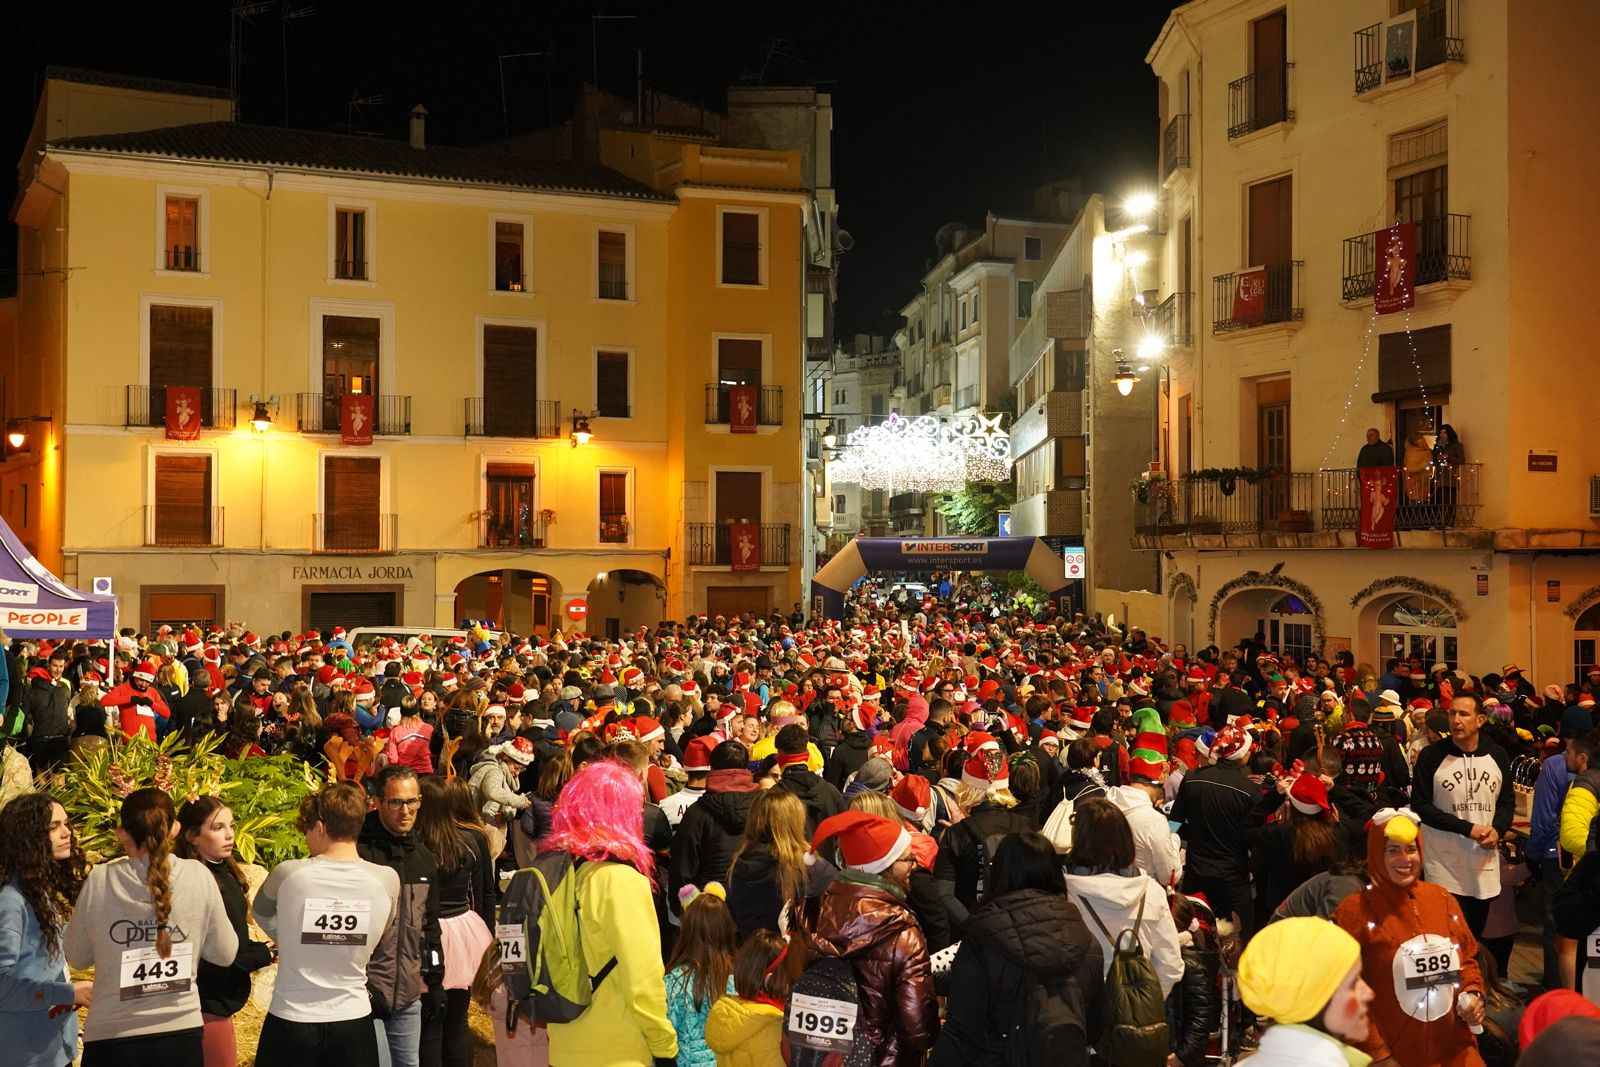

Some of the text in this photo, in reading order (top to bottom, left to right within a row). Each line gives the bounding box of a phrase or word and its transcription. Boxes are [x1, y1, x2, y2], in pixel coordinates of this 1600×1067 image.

[917, 542, 984, 552] INTERSPORT
[907, 555, 983, 565] www.intersport.es
[292, 566, 413, 579] FARMACIA JORDA
[8, 611, 81, 626] PEOPLE
[1441, 767, 1497, 794] SPURS
[1452, 803, 1492, 812] BASKETBALL
[314, 913, 358, 931] 439
[132, 960, 179, 981] 443
[1415, 953, 1451, 974] 589
[795, 1011, 848, 1036] 1995
